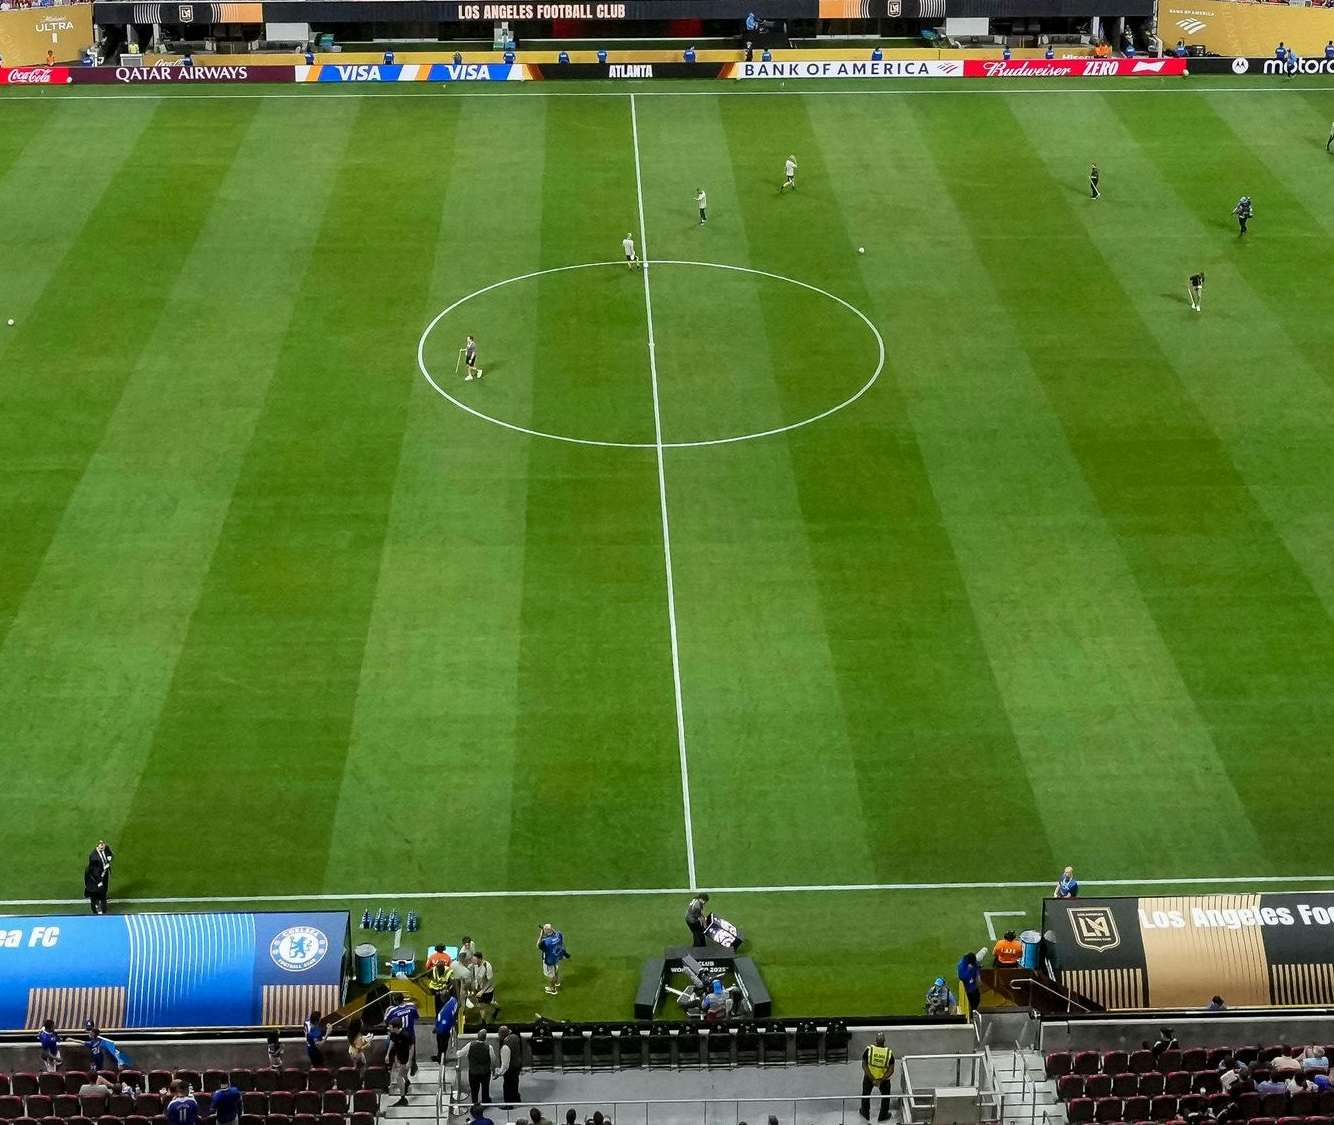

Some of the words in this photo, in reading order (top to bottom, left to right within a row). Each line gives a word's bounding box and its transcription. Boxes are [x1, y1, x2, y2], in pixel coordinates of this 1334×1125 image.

[458, 4, 480, 20] LOS
[483, 4, 533, 19] ANGELES
[537, 4, 593, 19] FOOTBALL
[597, 4, 626, 19] CLUB
[35, 22, 75, 32] ULTRA
[7, 68, 53, 85] Coca-Cola
[115, 66, 172, 83] QATAR
[177, 65, 248, 81] AIRWAYS
[334, 66, 382, 81] VISA
[445, 65, 491, 80] VISA
[608, 64, 653, 78] ATLANTA
[744, 63, 799, 77] BANK
[806, 63, 831, 76] OF
[837, 61, 930, 76] AMERICA
[982, 60, 1073, 77] Budweiser
[1082, 60, 1119, 76] ZERO
[1138, 908, 1185, 931] Los
[1194, 905, 1294, 931] Angeles
[27, 925, 60, 948] FC
[278, 957, 302, 970] FOOTBALL
